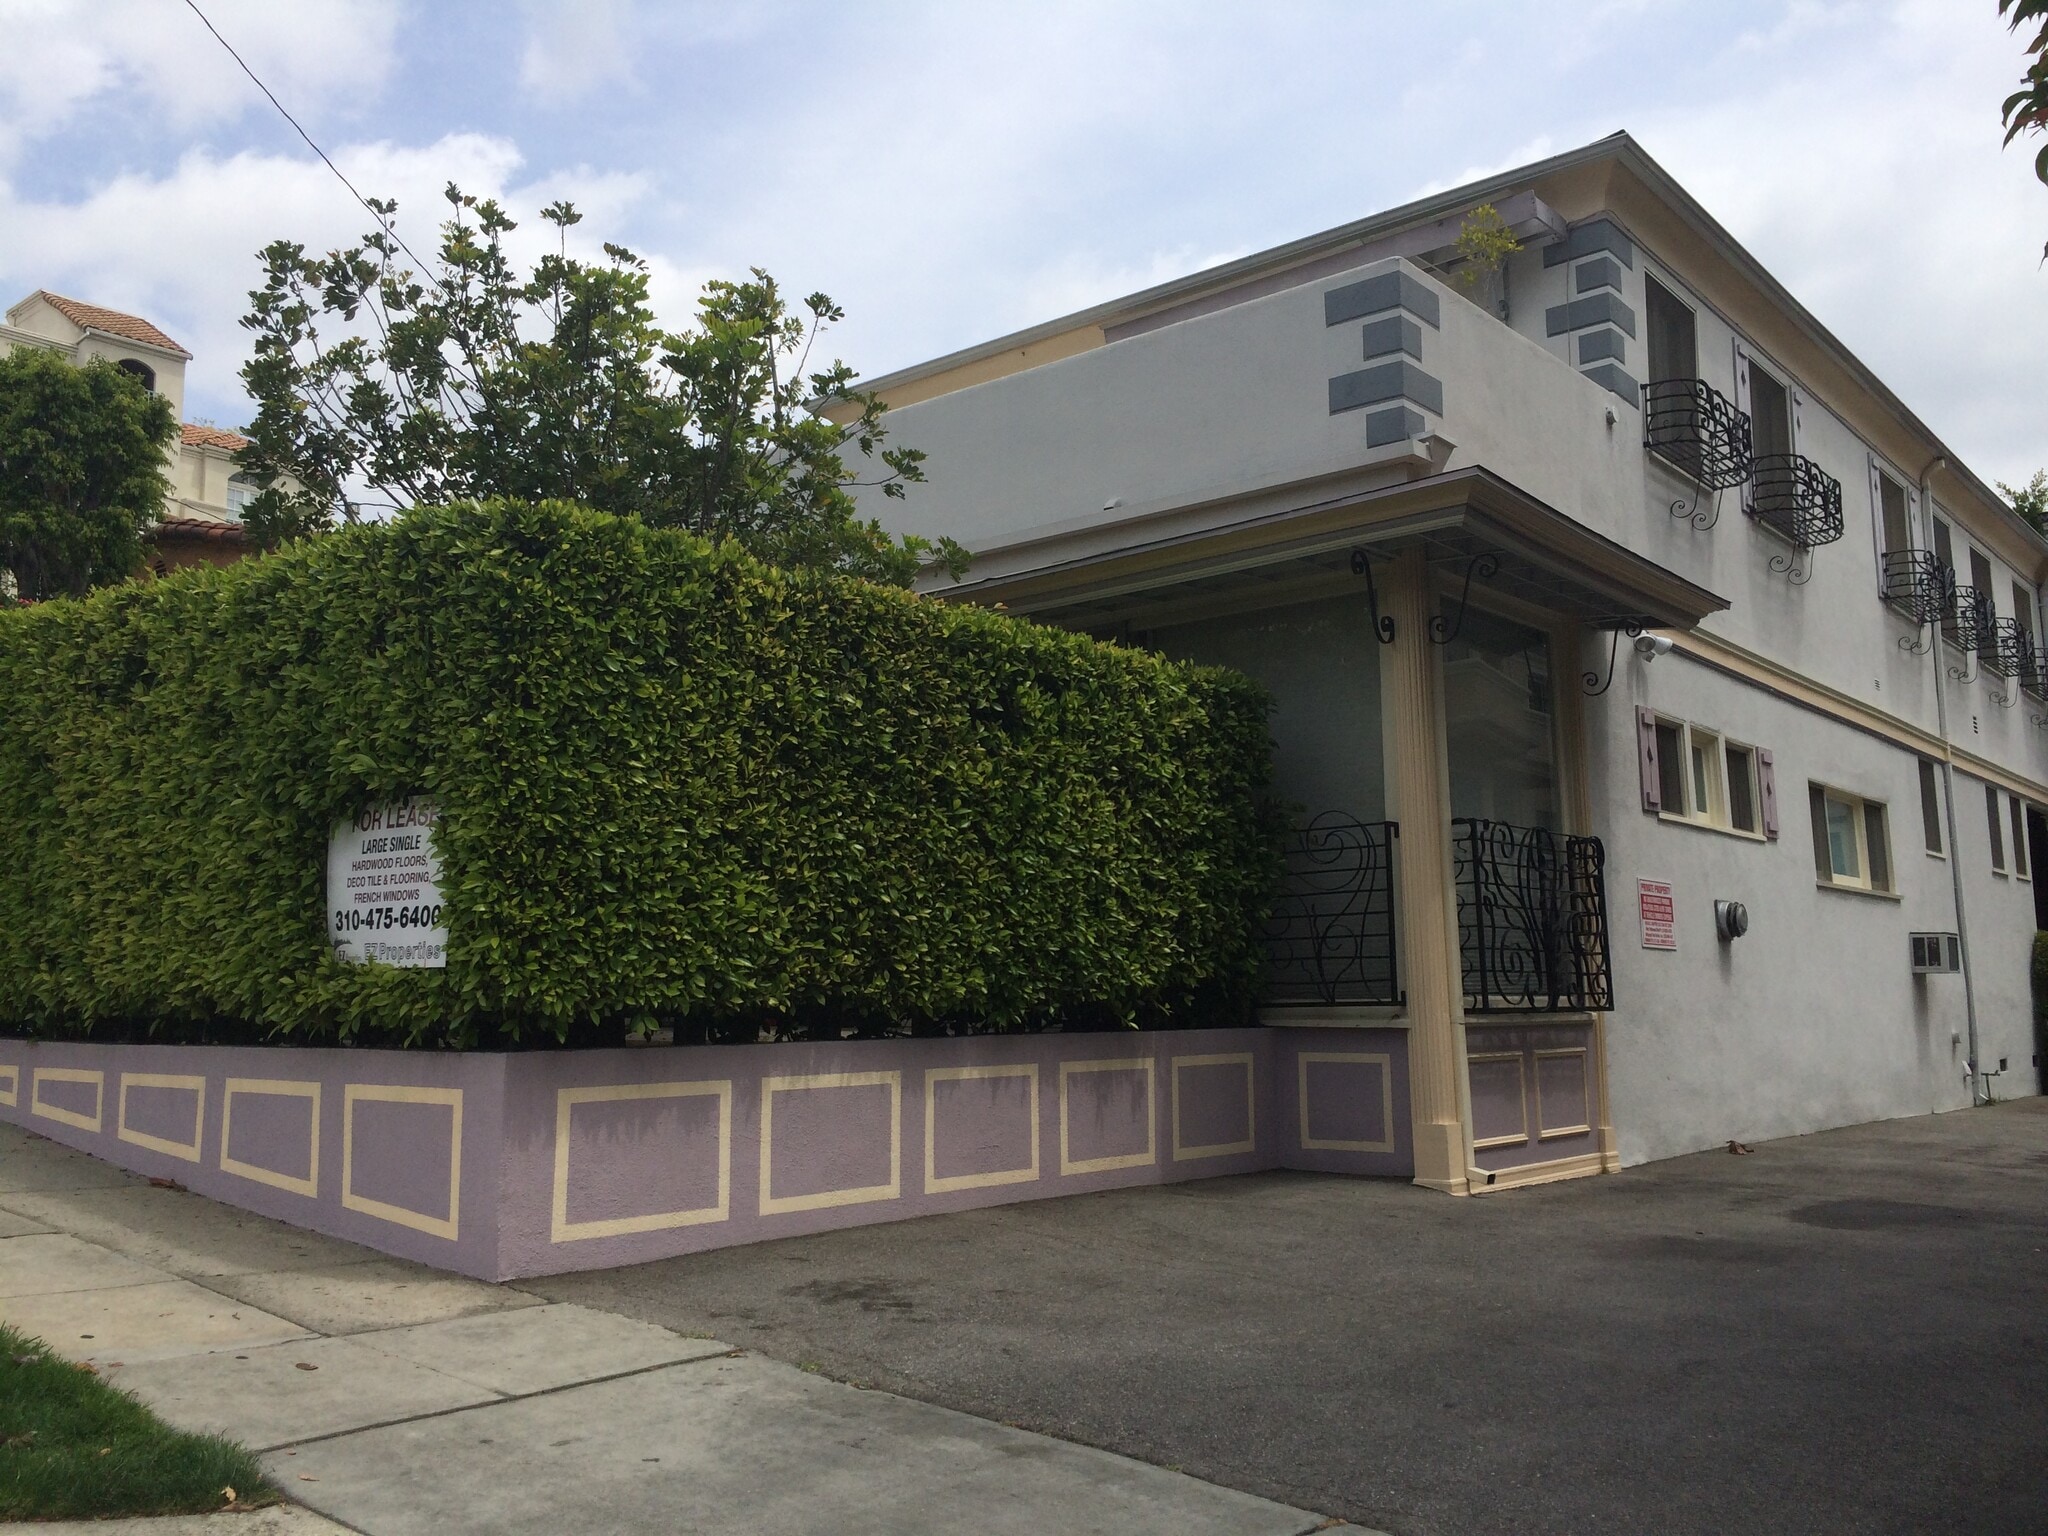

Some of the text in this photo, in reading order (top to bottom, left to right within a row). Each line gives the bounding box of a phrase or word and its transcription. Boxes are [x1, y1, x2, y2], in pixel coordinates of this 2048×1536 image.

[361, 834, 422, 855] LARGE SINGLE
[351, 854, 428, 872] HARDWOOD FLOORS,
[346, 871, 431, 888] DECO TILE & FLOORING,
[354, 889, 420, 904] FRENCH WINDOWS
